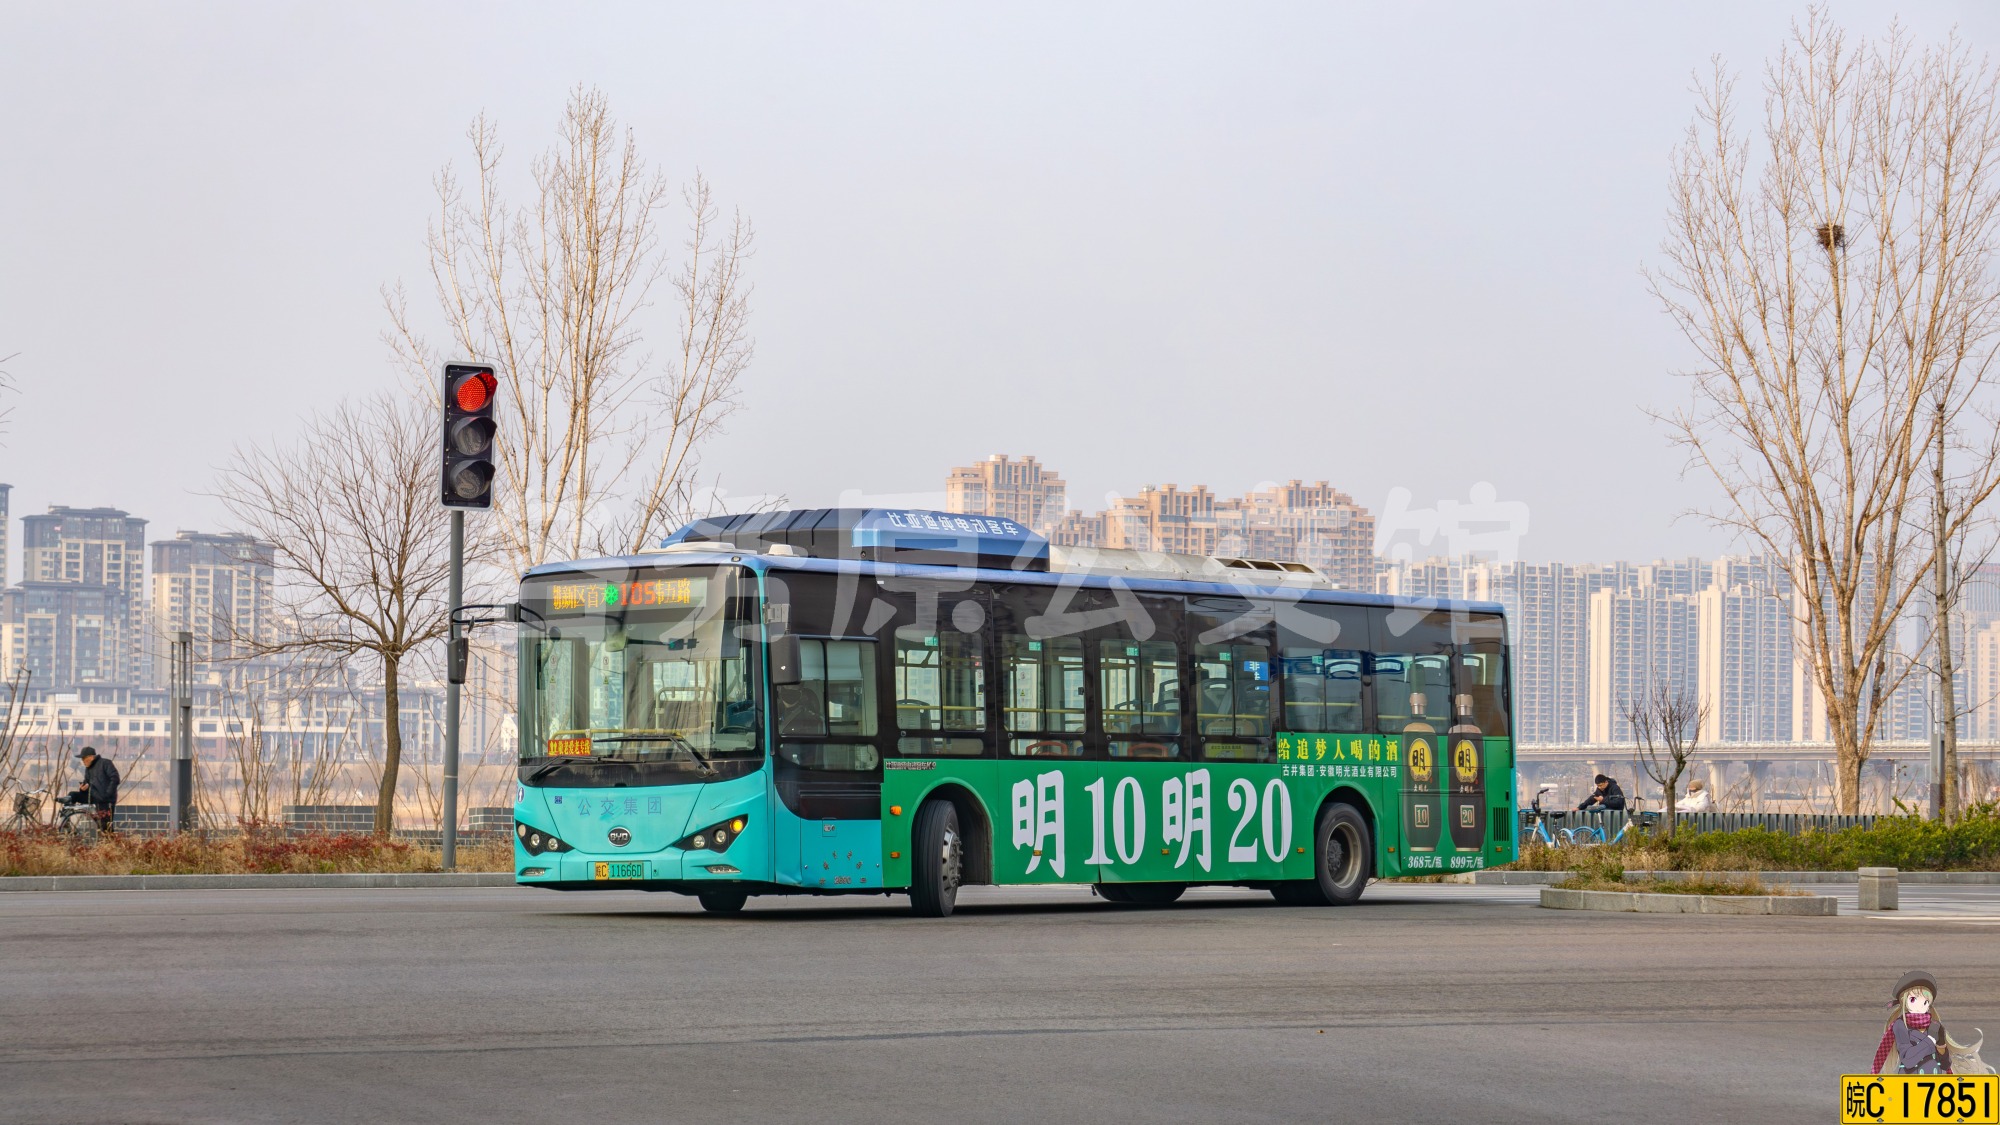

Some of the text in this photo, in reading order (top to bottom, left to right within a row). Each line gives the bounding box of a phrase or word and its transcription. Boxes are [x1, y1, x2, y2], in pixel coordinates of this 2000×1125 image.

[886, 511, 1020, 537] 比亚迪纯电动客车
[620, 582, 657, 606] 105
[1278, 739, 1398, 762] 给追梦人喝的酒
[1282, 764, 1397, 778] 古井集团·安徽明光酒业有限公司
[577, 796, 662, 816] 公交集团
[1416, 809, 1428, 824] 10
[1462, 809, 1475, 824] 20
[610, 832, 628, 841] BYD
[1407, 856, 1443, 869] 368元/瓶
[1450, 857, 1484, 869] 899元/瓶
